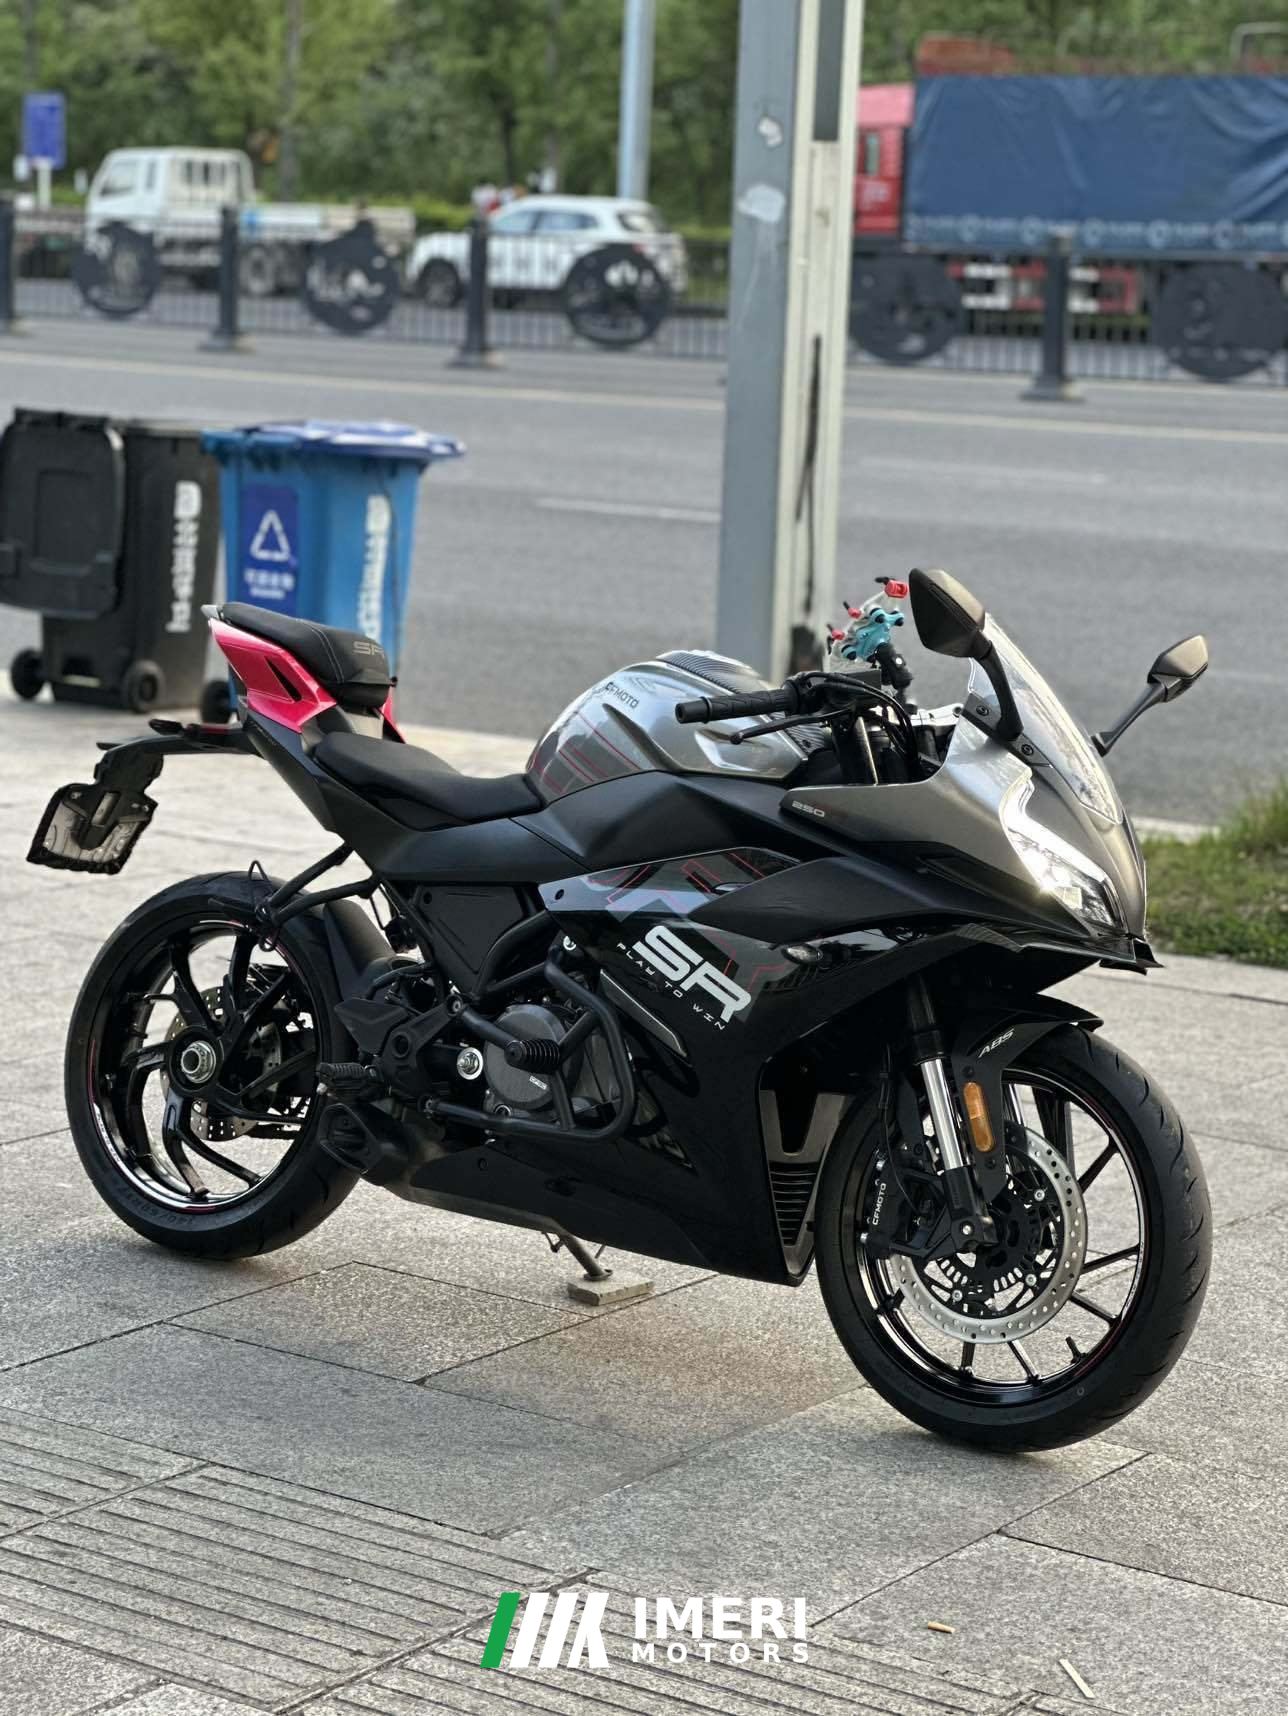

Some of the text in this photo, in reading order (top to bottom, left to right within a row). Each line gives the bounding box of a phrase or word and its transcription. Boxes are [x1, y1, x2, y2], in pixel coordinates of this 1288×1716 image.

[791, 800, 826, 818] 250
[616, 942, 726, 1031] PLAY TO WIN
[632, 925, 752, 1024] SR
[978, 1028, 1015, 1058] ABS
[872, 1182, 887, 1226] CFMOTO
